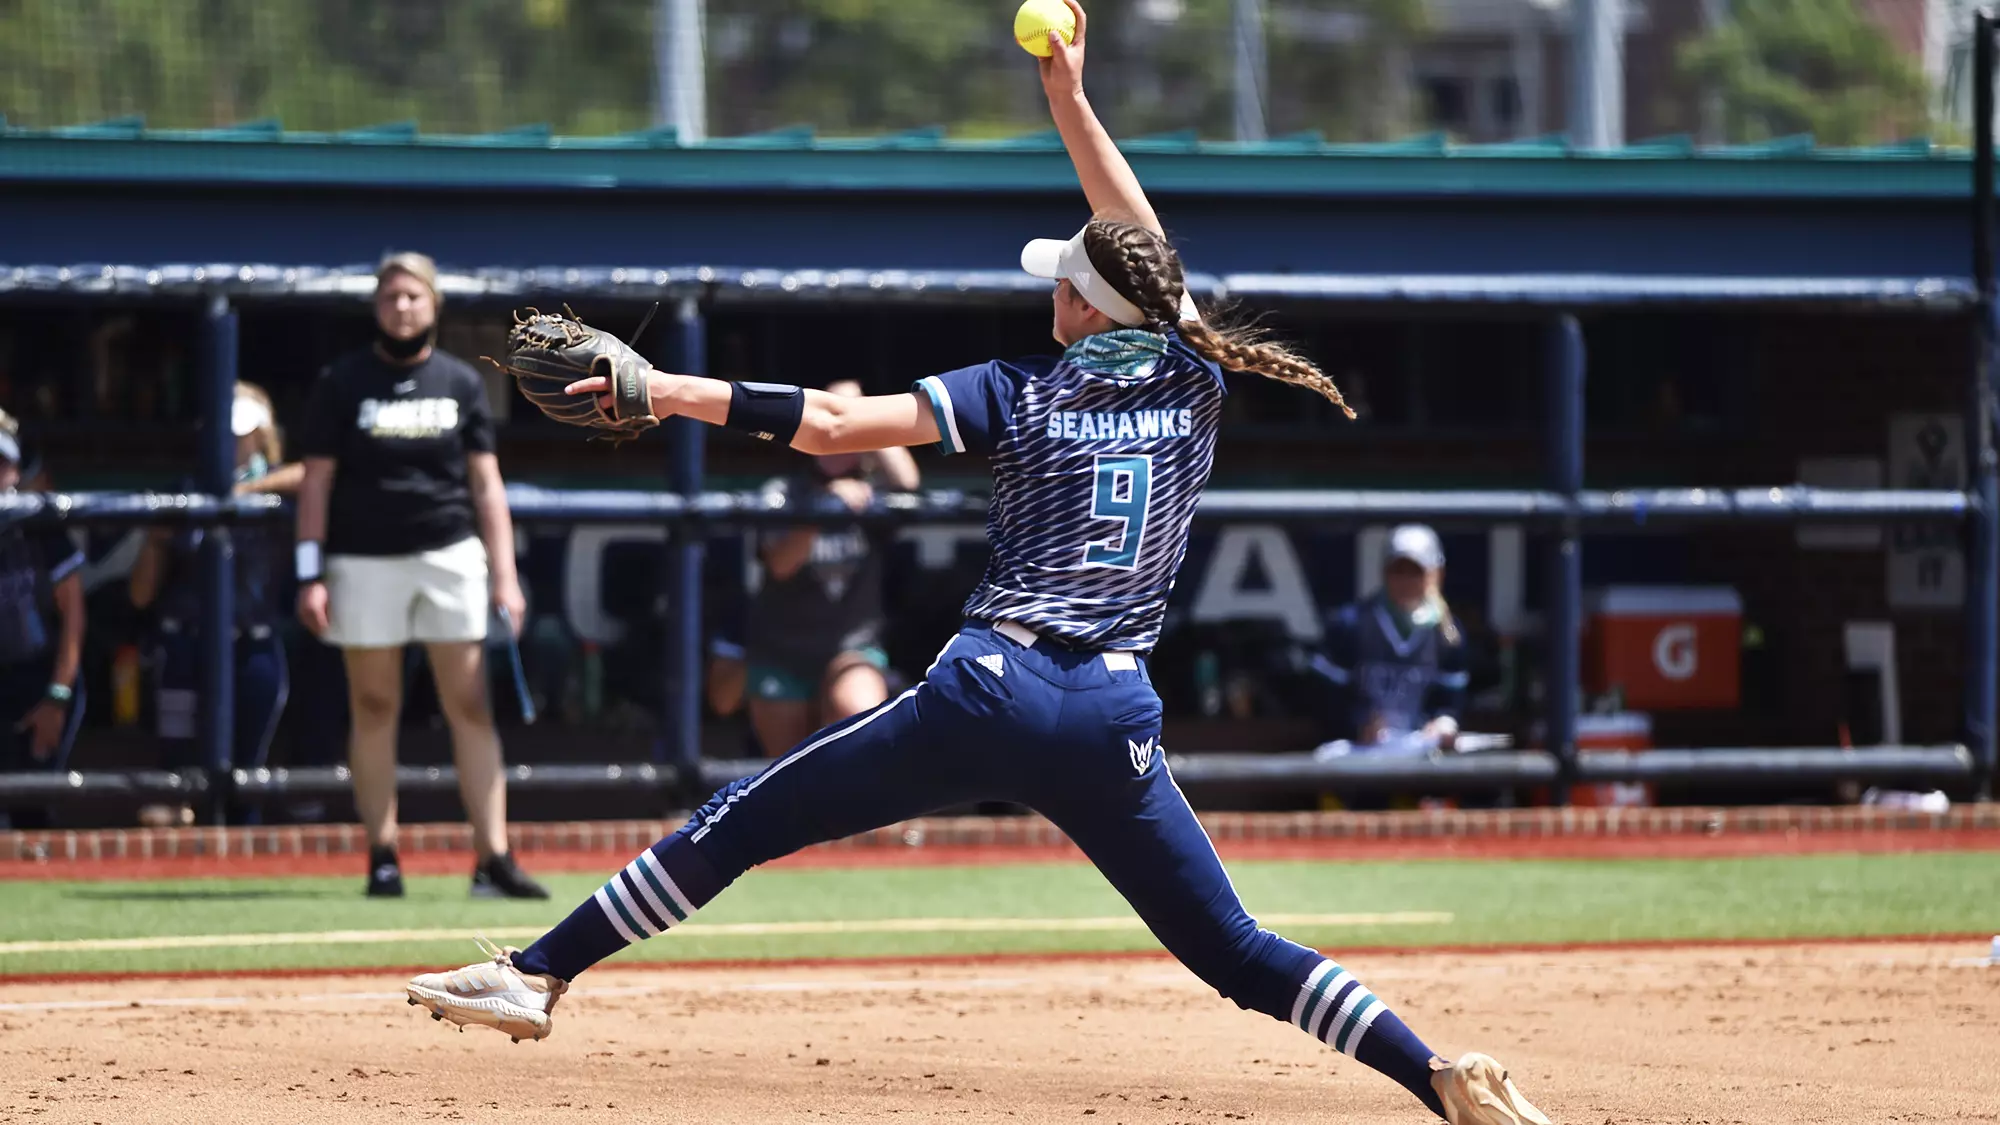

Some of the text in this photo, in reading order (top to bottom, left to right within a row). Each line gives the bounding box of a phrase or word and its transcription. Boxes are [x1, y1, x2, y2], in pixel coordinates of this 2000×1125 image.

[1047, 409, 1192, 440] SEAHAWKS
[1083, 454, 1152, 571] 9
[1653, 624, 1698, 680] G
